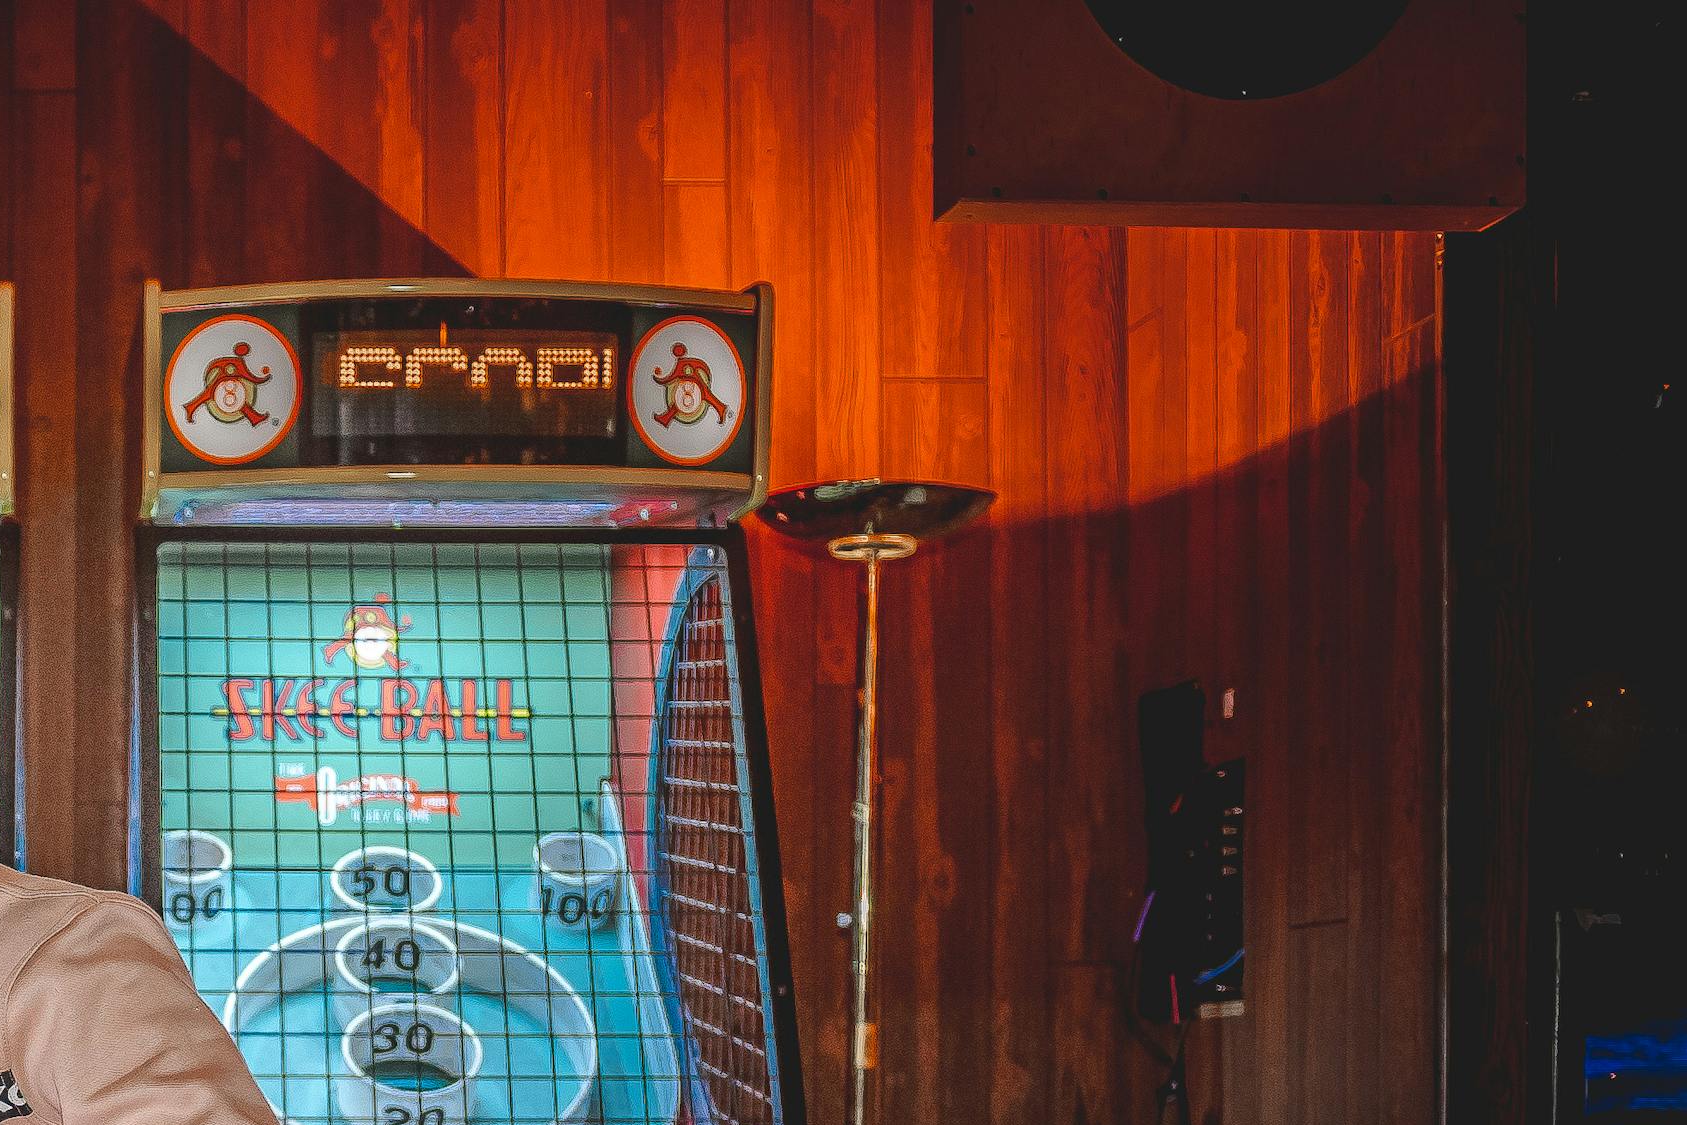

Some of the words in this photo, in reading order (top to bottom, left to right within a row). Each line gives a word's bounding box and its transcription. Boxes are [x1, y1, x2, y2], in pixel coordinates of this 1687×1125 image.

[221, 678, 358, 741] SKEE
[380, 678, 528, 741] BALL
[351, 866, 410, 897] 50
[363, 939, 421, 972] 40
[373, 1023, 434, 1054] 30
